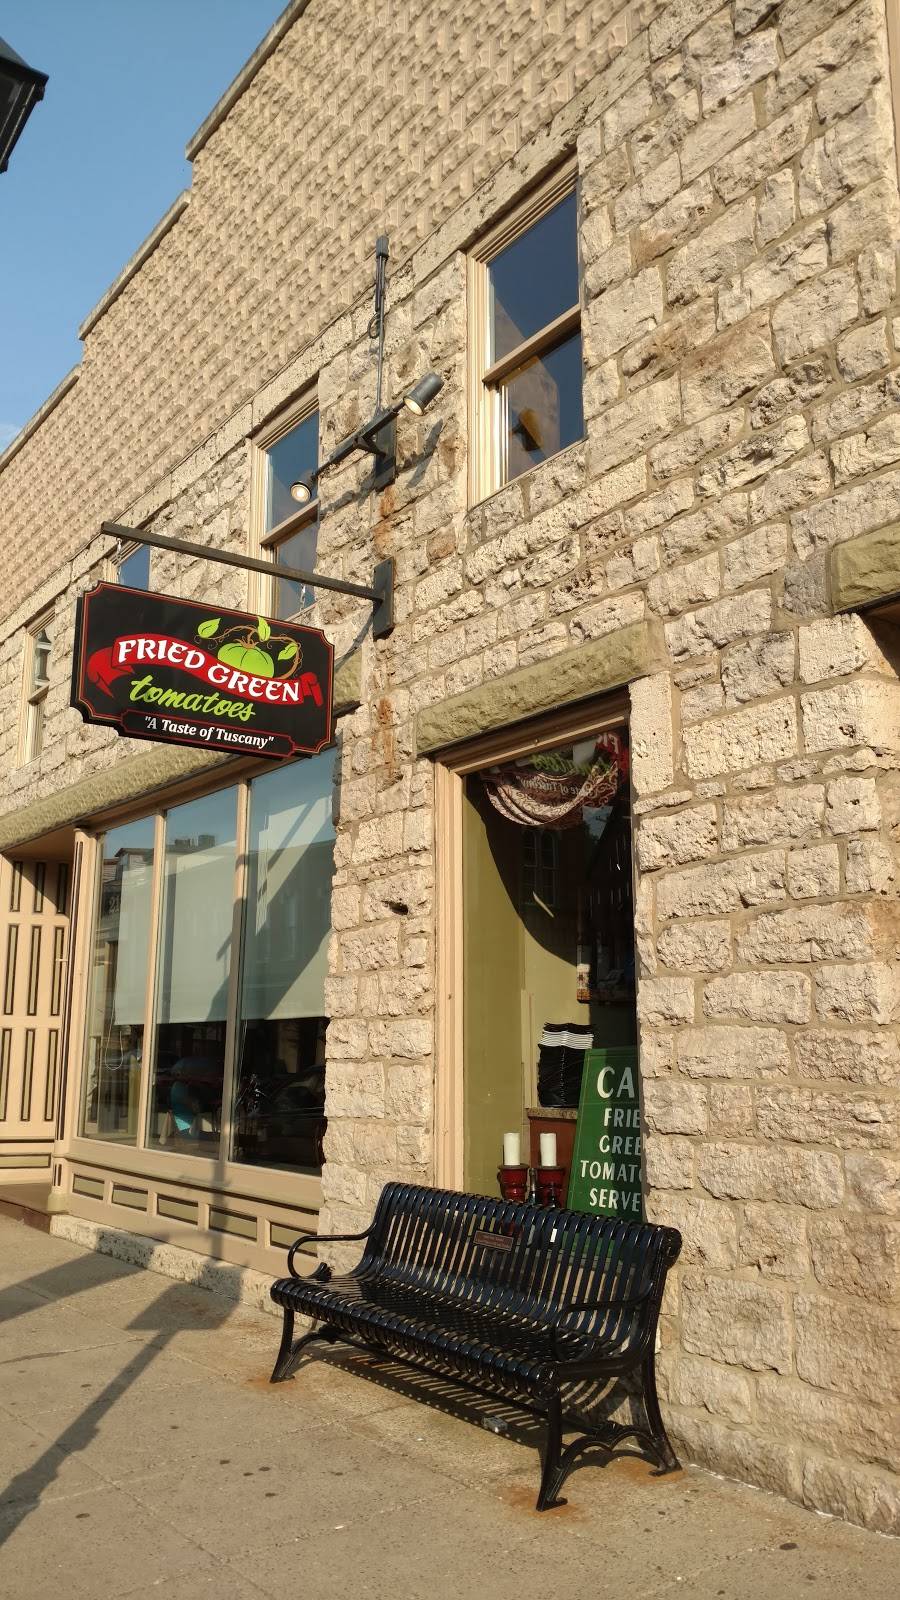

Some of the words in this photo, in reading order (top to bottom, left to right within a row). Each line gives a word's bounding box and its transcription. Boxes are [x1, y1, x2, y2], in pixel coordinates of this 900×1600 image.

[117, 638, 205, 670] FRIED
[207, 663, 300, 703] GREEN
[129, 674, 256, 722] tomatoes
[144, 715, 158, 730] "A
[161, 719, 198, 738] Taste
[199, 726, 216, 741] of
[216, 728, 275, 749] Tuscany"
[580, 1160, 642, 1183] TOMAT
